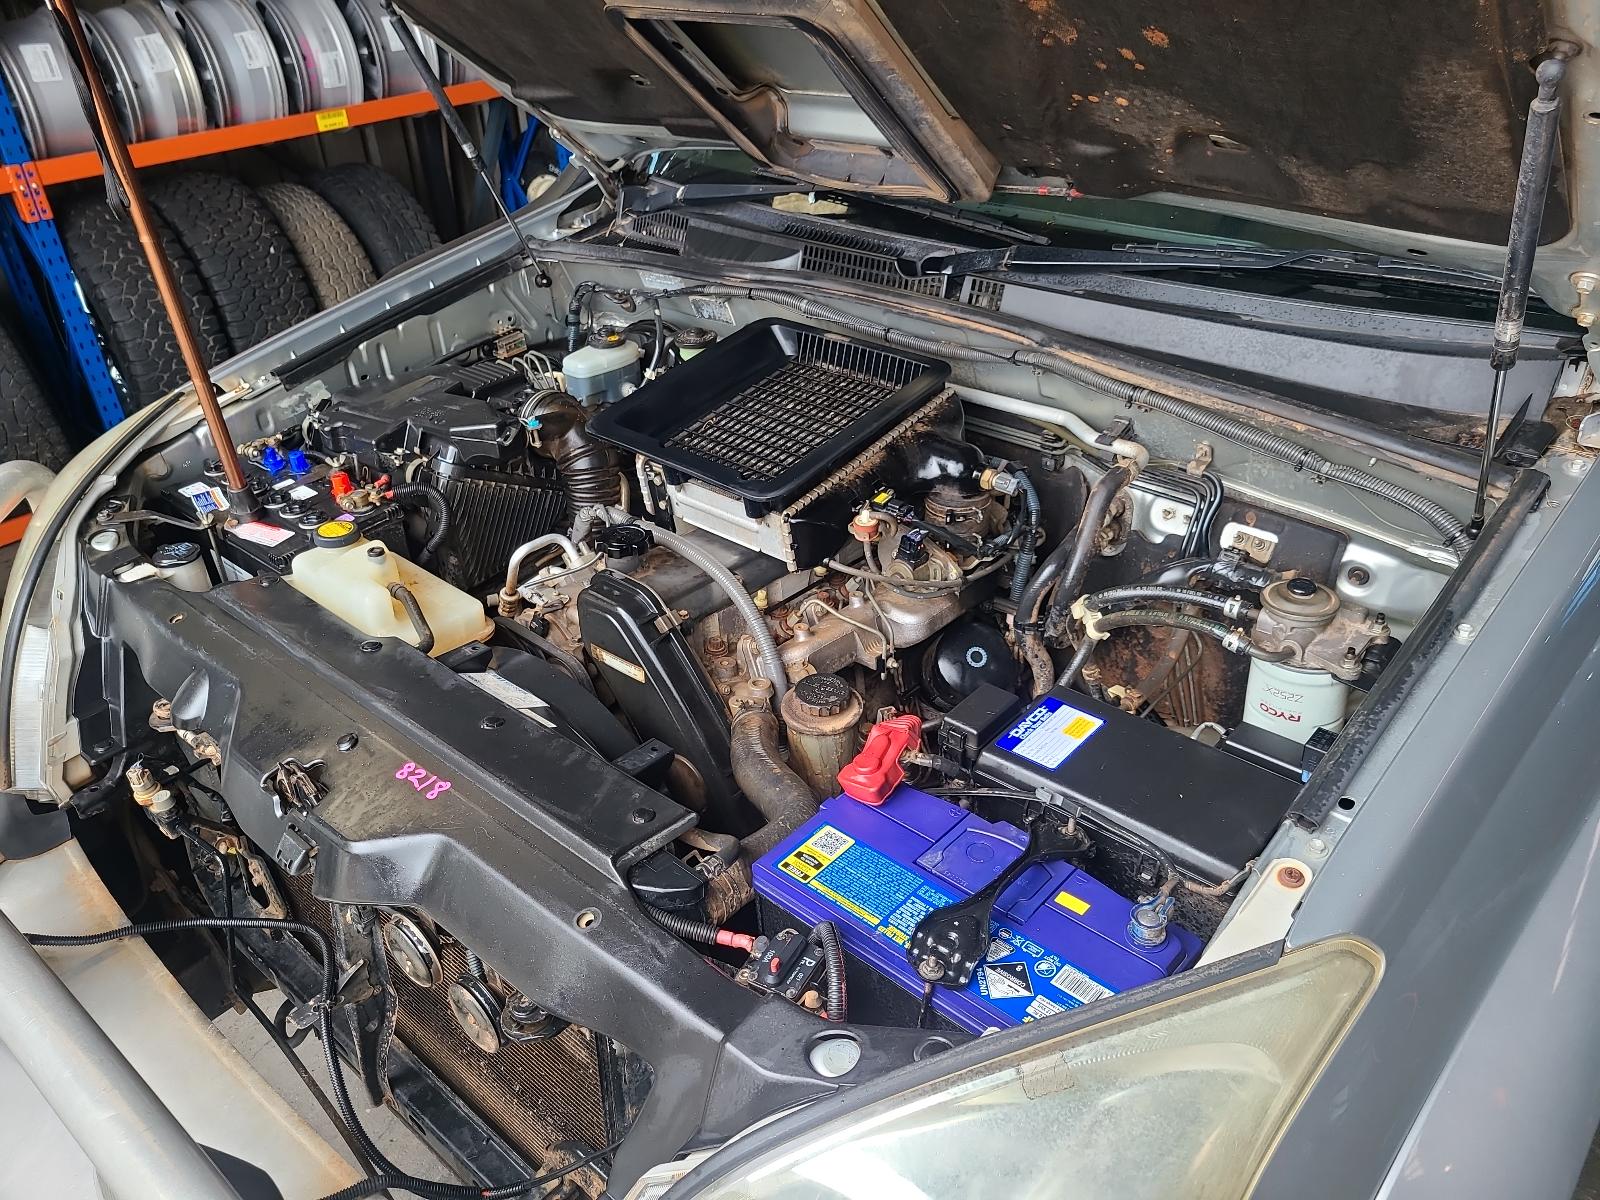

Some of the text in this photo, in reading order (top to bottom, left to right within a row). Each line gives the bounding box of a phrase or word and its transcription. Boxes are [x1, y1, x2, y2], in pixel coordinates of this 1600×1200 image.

[1264, 687, 1304, 703] Z252X
[1008, 705, 1048, 738] DAYCO
[1259, 703, 1301, 722] RYCO
[786, 864, 805, 877] FREE
[762, 949, 775, 963] 100A
[976, 967, 989, 996] UN2794
[994, 967, 1026, 988] CORROSIVE
